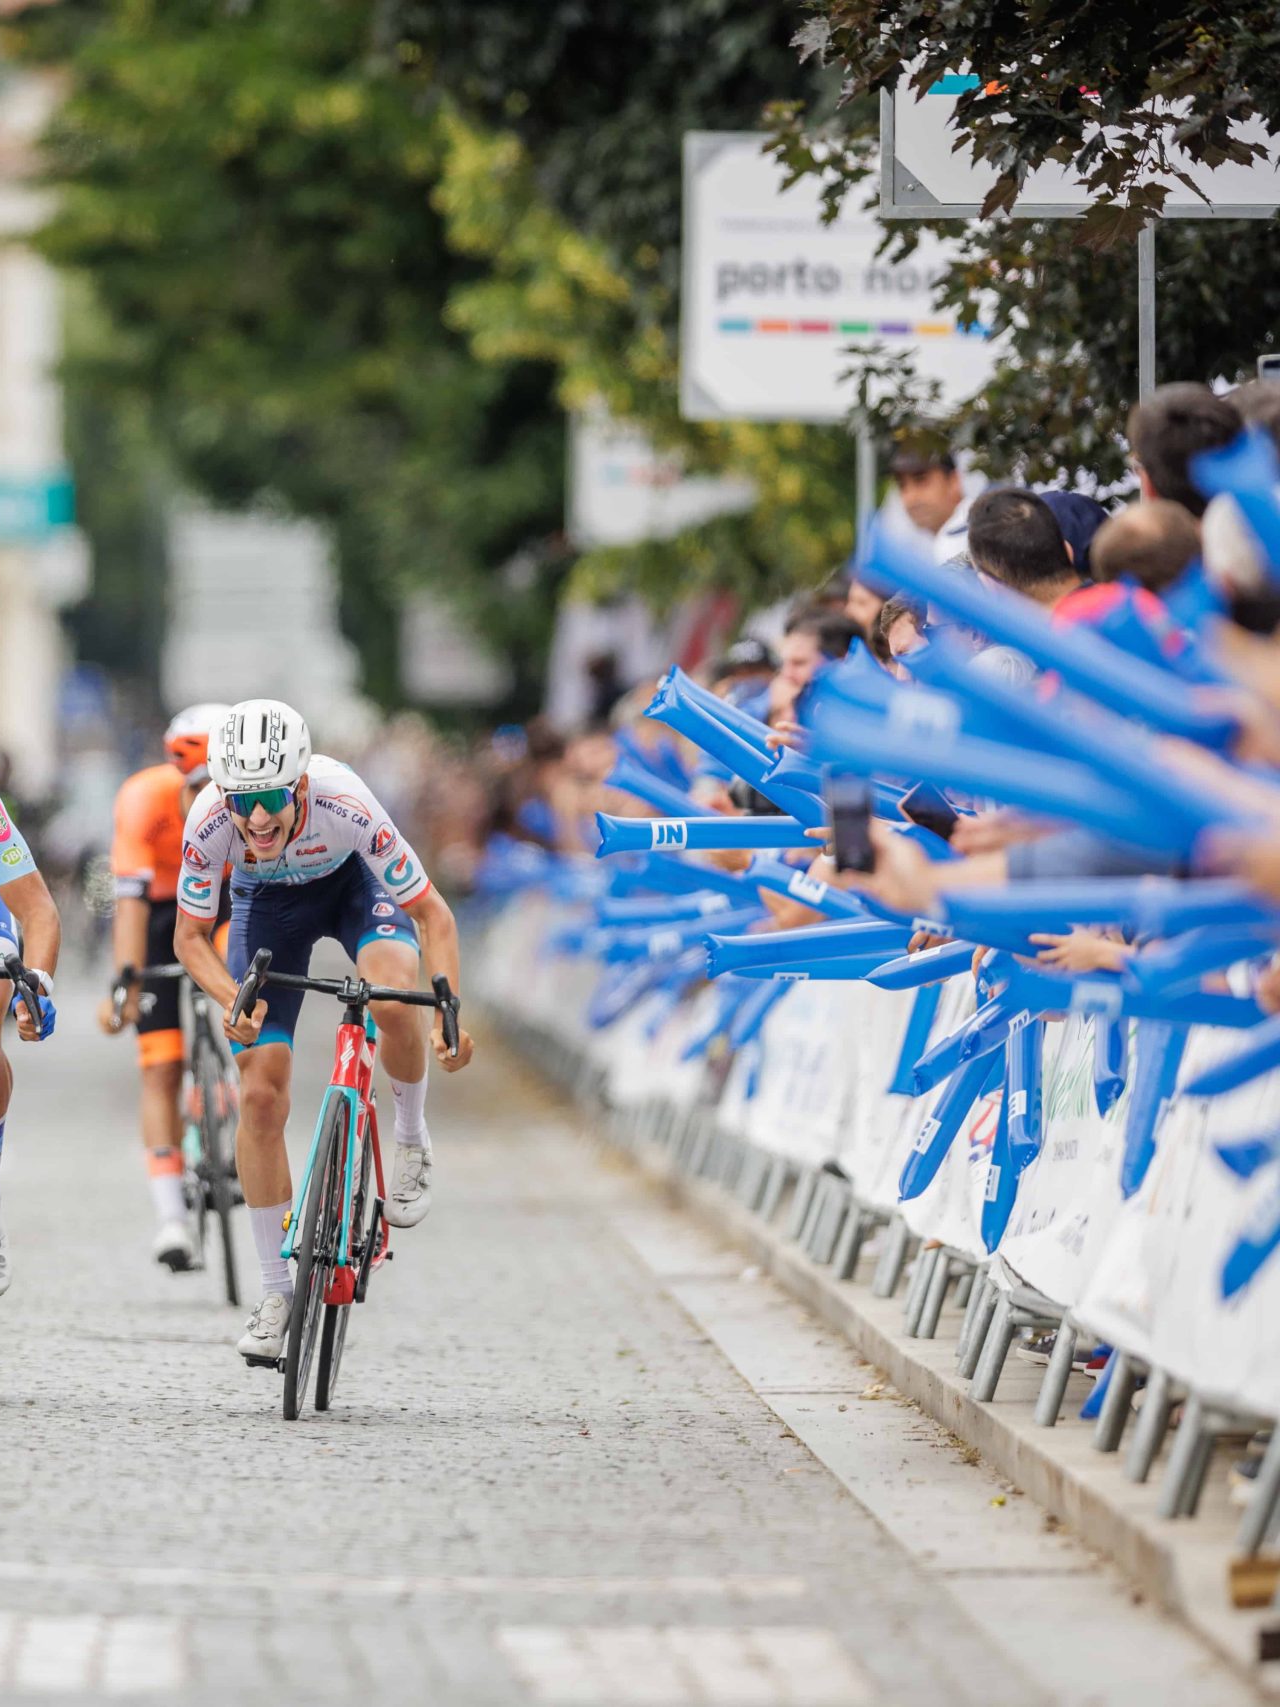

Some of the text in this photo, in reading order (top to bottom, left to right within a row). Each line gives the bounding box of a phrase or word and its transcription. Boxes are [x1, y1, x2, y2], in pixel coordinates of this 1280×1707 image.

[716, 258, 842, 304] porto
[226, 713, 238, 768] FORCE
[269, 710, 281, 765] FORCE
[237, 782, 272, 790] FORCE
[198, 812, 229, 842] MARCOS
[315, 798, 370, 829] MARCOS CAR
[656, 824, 683, 845] JN
